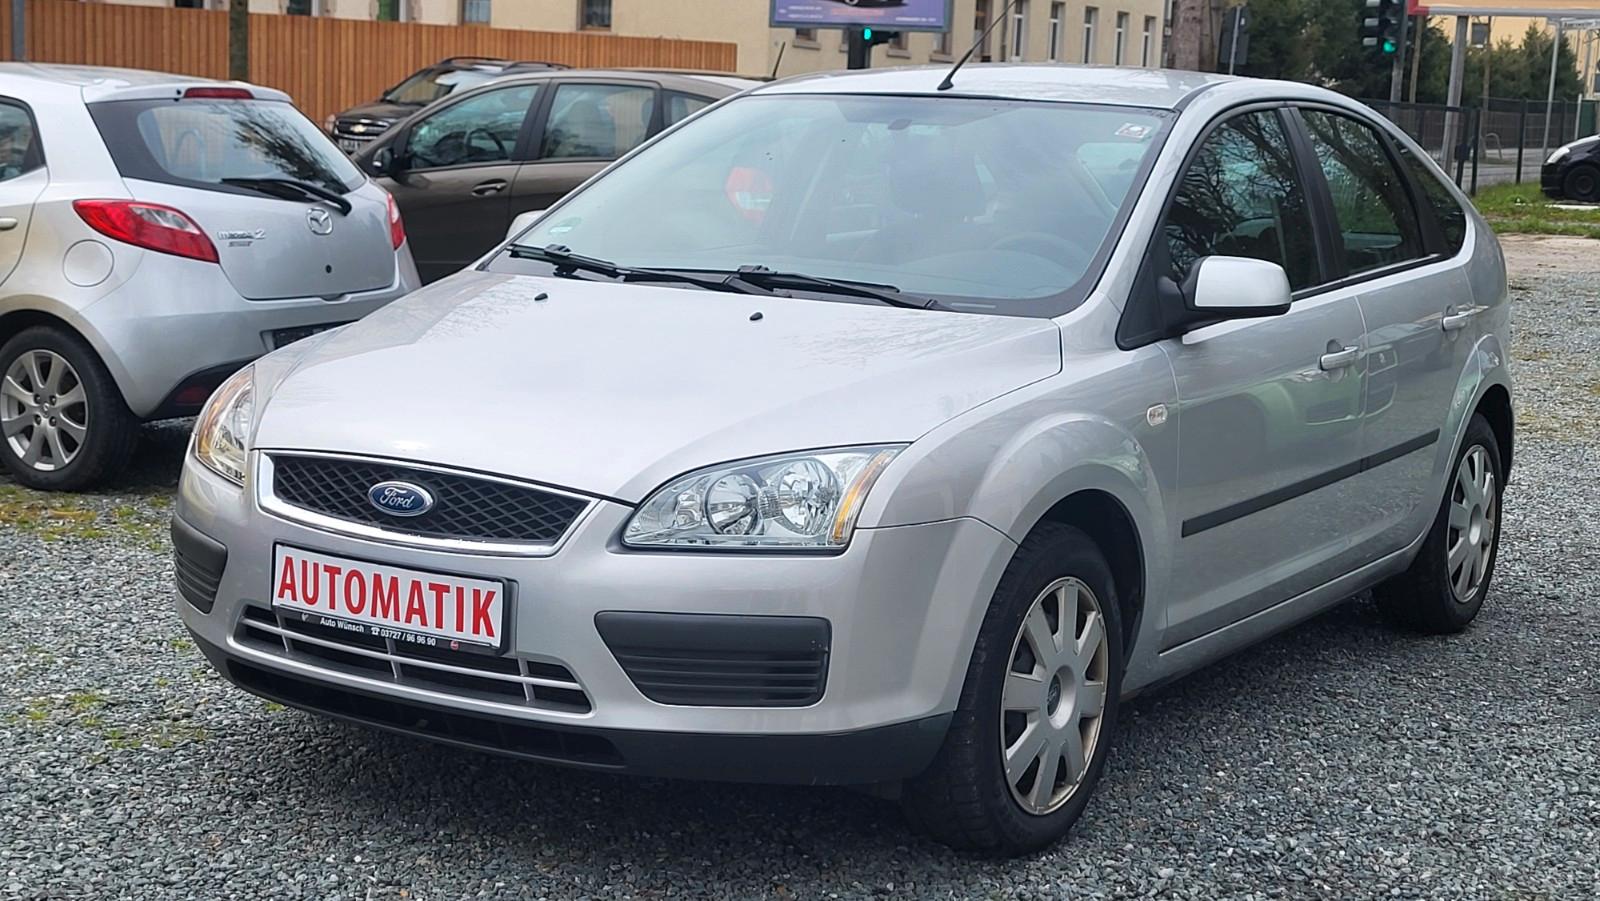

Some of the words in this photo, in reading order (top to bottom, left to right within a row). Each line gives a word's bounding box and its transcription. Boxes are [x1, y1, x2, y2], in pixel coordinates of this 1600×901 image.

[380, 487, 415, 508] Ford
[277, 556, 496, 638] AUTOMATIK
[320, 617, 336, 627] Auto
[337, 620, 364, 632] Wünsch
[380, 629, 401, 639] 03727
[427, 638, 436, 646] 90
